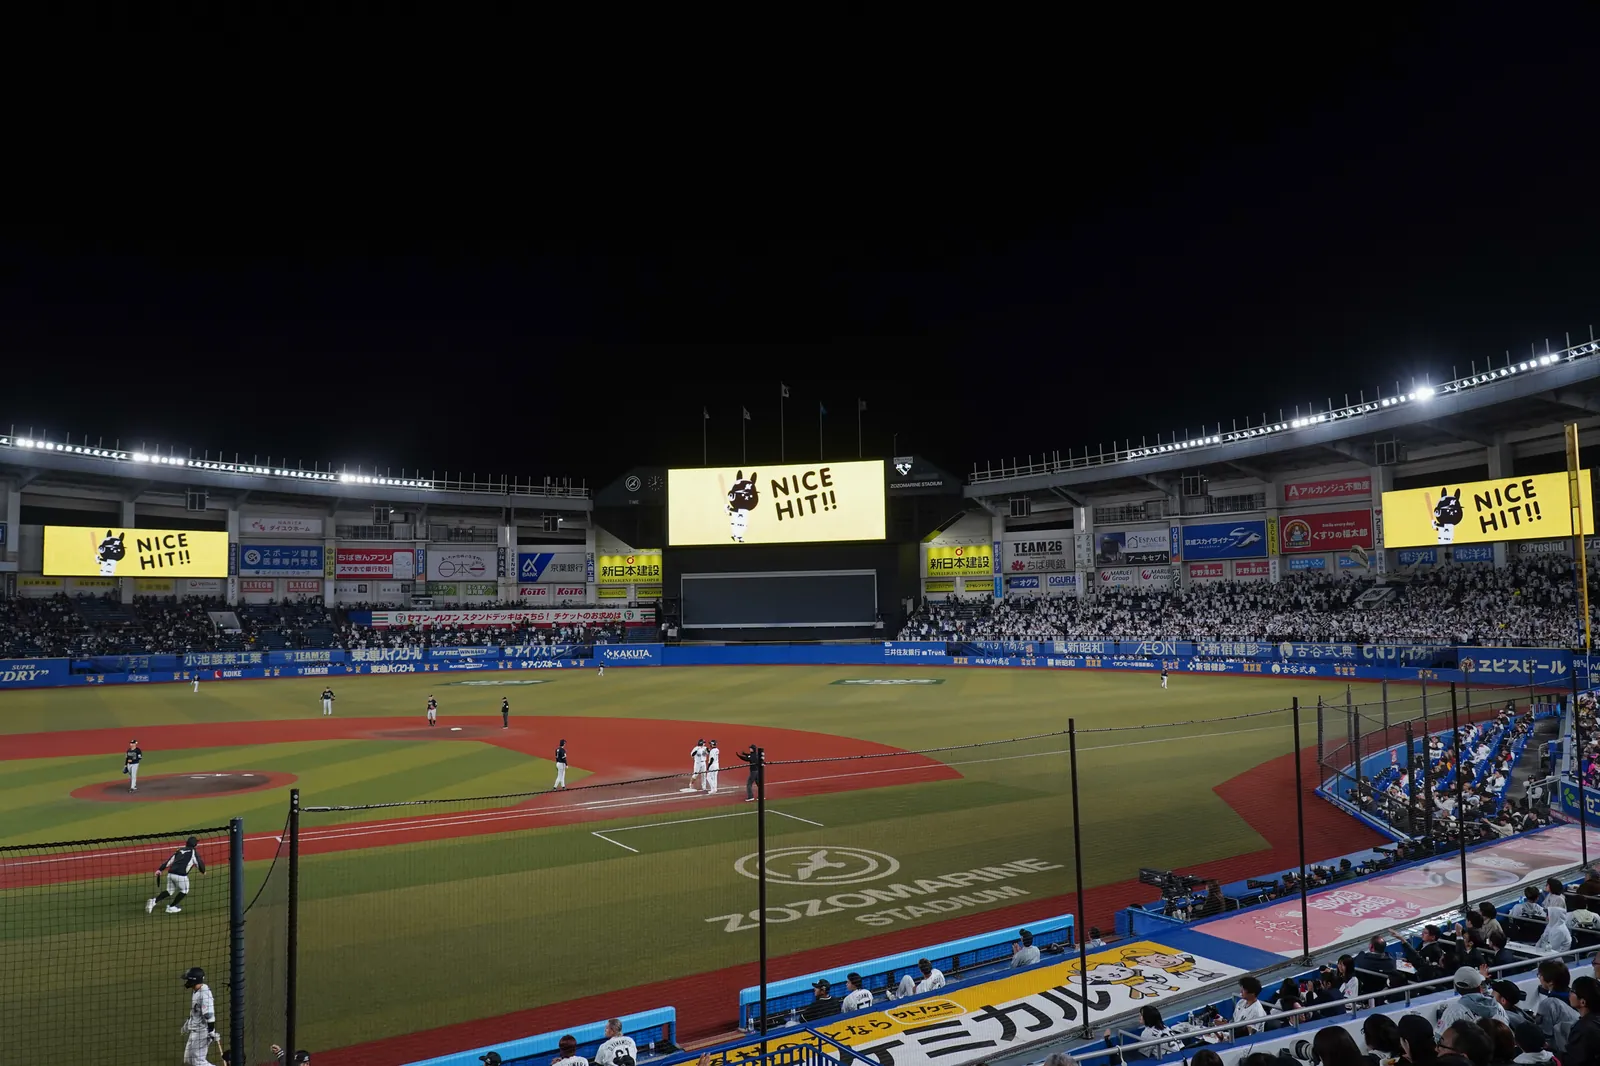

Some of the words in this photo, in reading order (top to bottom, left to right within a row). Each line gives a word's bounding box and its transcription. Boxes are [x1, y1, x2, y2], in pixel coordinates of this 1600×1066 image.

[770, 467, 833, 498] NICE
[1300, 481, 1370, 495] アルカンジュ不動産
[1474, 479, 1536, 512] NICE
[775, 490, 837, 521] HIT!!
[1479, 501, 1542, 534] HIT!!
[1312, 528, 1368, 540] くすりの福太郎
[136, 533, 189, 553] NICE
[1185, 537, 1234, 546] 京成スカイライナー
[139, 549, 191, 570] HIT!!
[263, 549, 318, 558] スポーツ健康
[337, 554, 393, 562] ちばぎんアプリ
[1400, 552, 1435, 562] 電洋社
[1456, 548, 1492, 560] 電洋社
[263, 558, 318, 566] 医療専門学校
[551, 563, 583, 573] 京葉銀行
[930, 556, 990, 570] 新日本建設
[1027, 559, 1066, 570] ちば興銀
[602, 565, 660, 576] 新日本建設
[554, 611, 621, 620] チケットのお求めは
[884, 648, 920, 656] 三井住友銀行
[1067, 641, 1104, 654] 新昭和
[1295, 645, 1355, 658] 古谷式典
[184, 652, 262, 666] 小池酸素工業
[1054, 659, 1075, 667] 新昭和
[1281, 666, 1317, 675] 古谷式典
[704, 858, 1064, 933] ZOZOMARINE
[855, 885, 1031, 927] STADIUM
